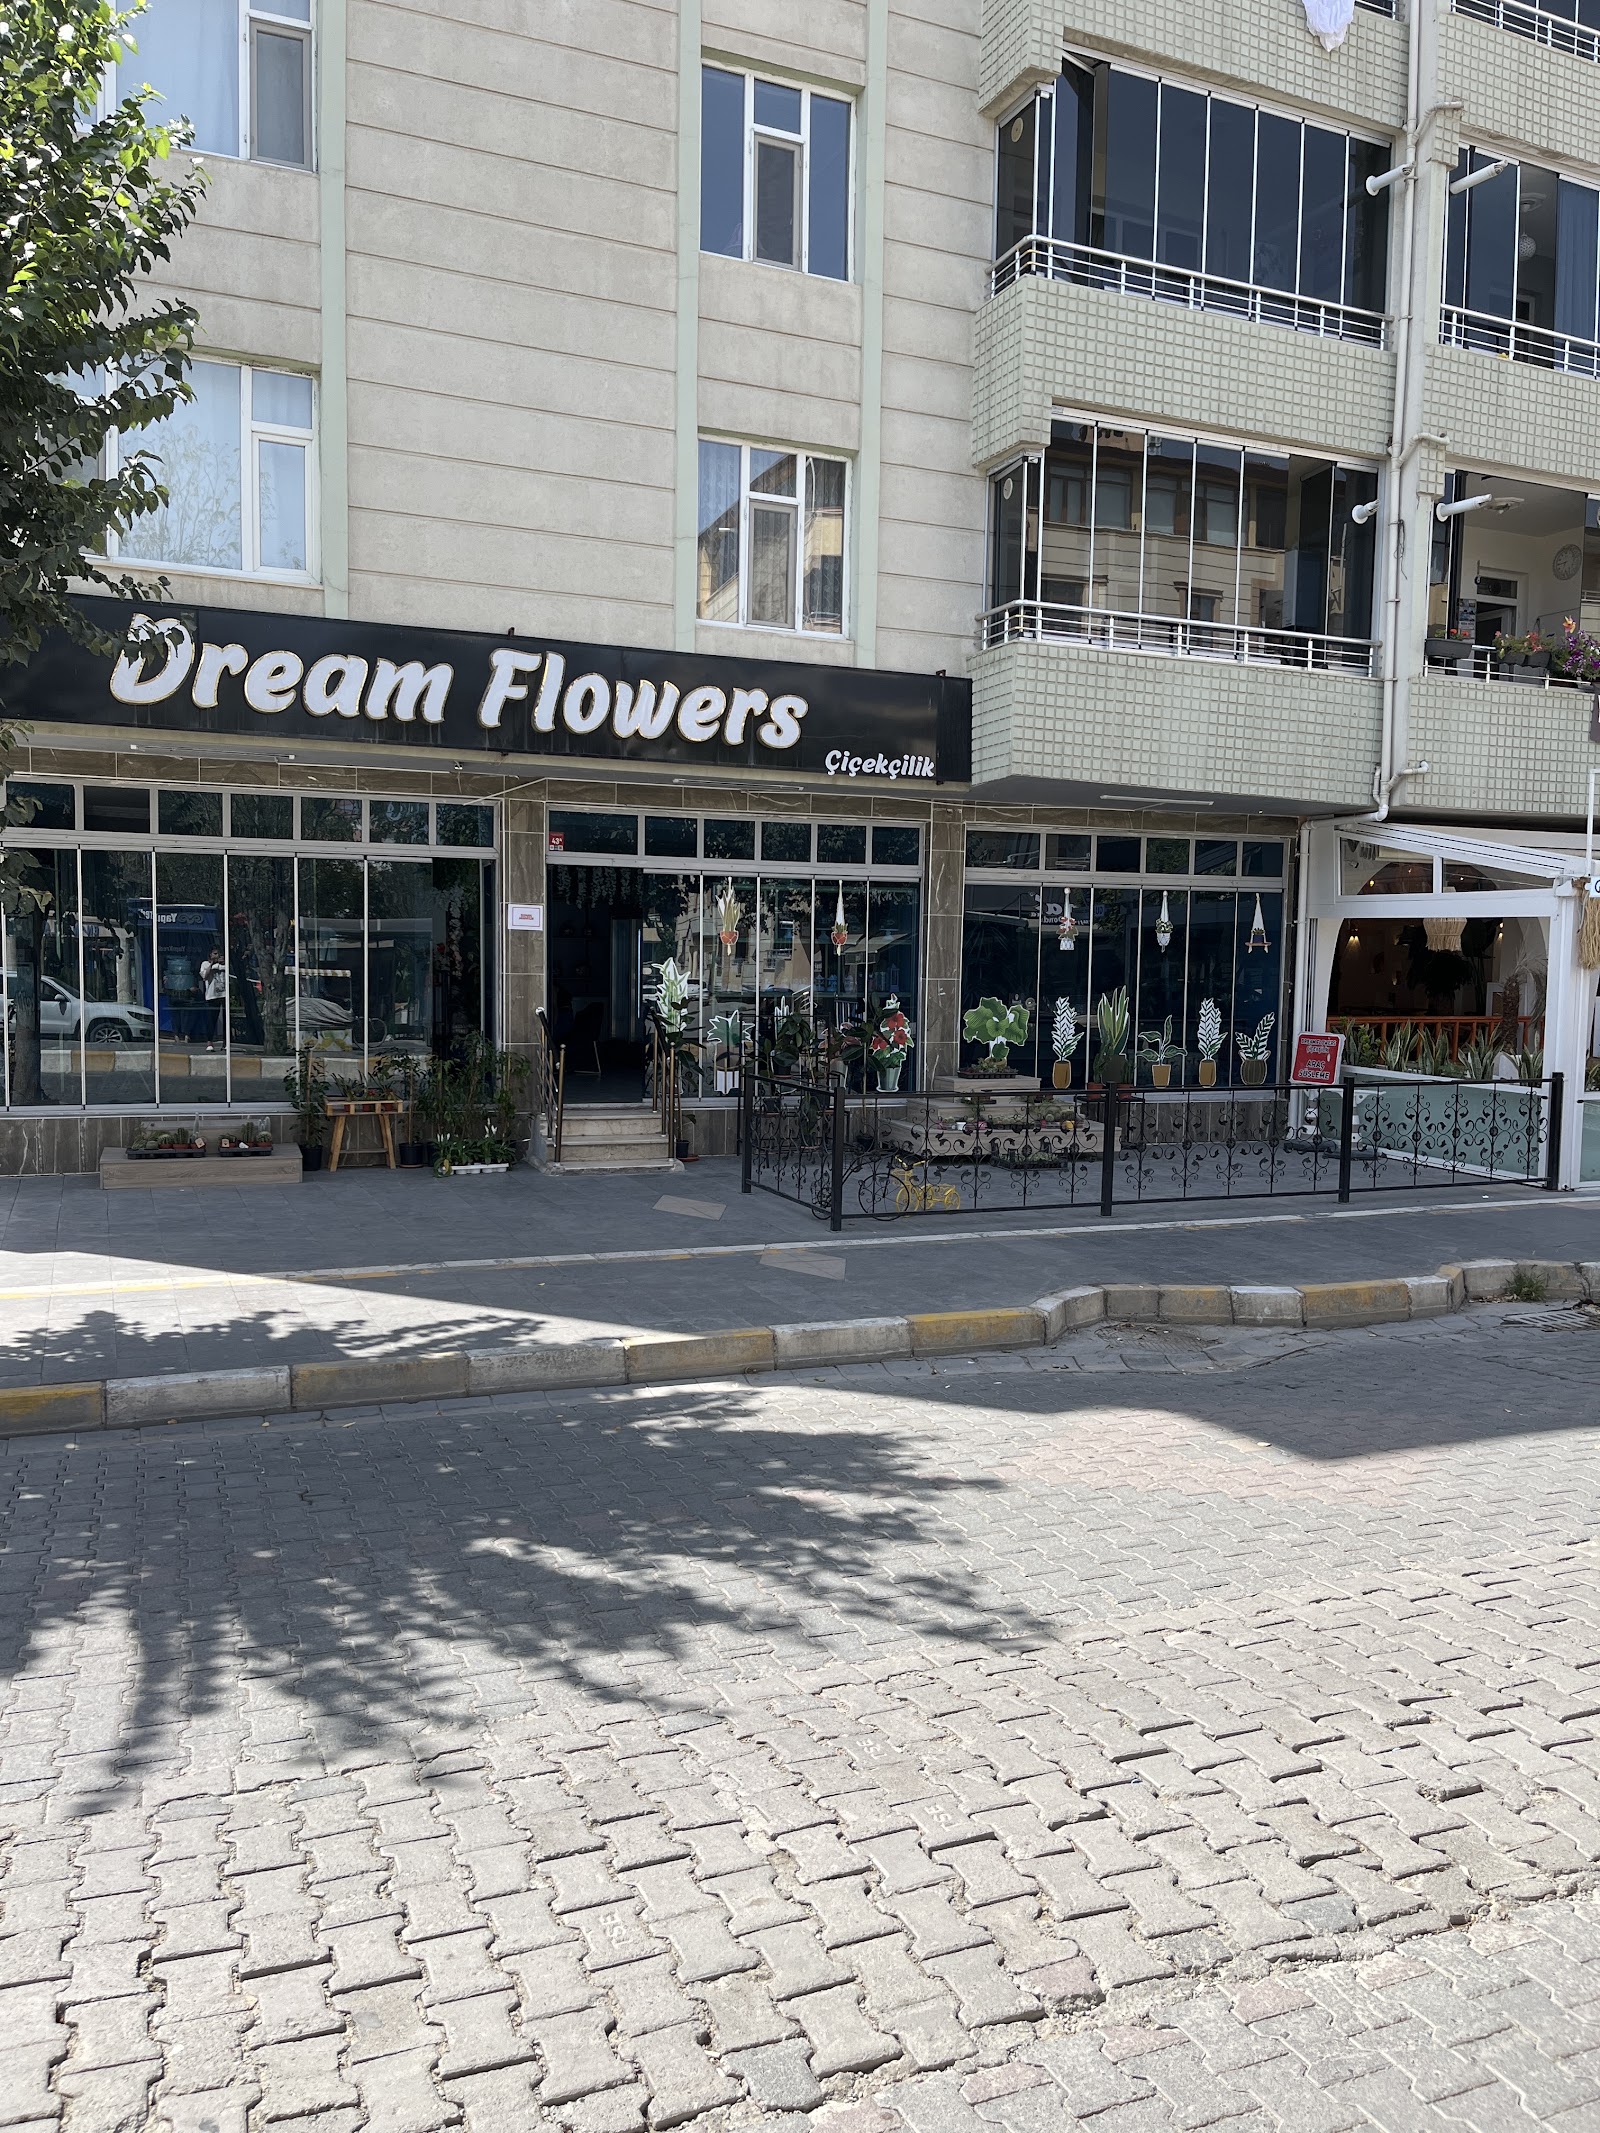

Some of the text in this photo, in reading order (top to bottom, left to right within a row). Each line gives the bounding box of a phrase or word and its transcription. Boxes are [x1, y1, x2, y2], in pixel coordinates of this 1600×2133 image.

[110, 612, 809, 749] Dream Flowers
[825, 750, 935, 780] Çiçekçilik
[1298, 1068, 1330, 1080] SÜSLEME
[1306, 1059, 1325, 1070] ARAÇ
